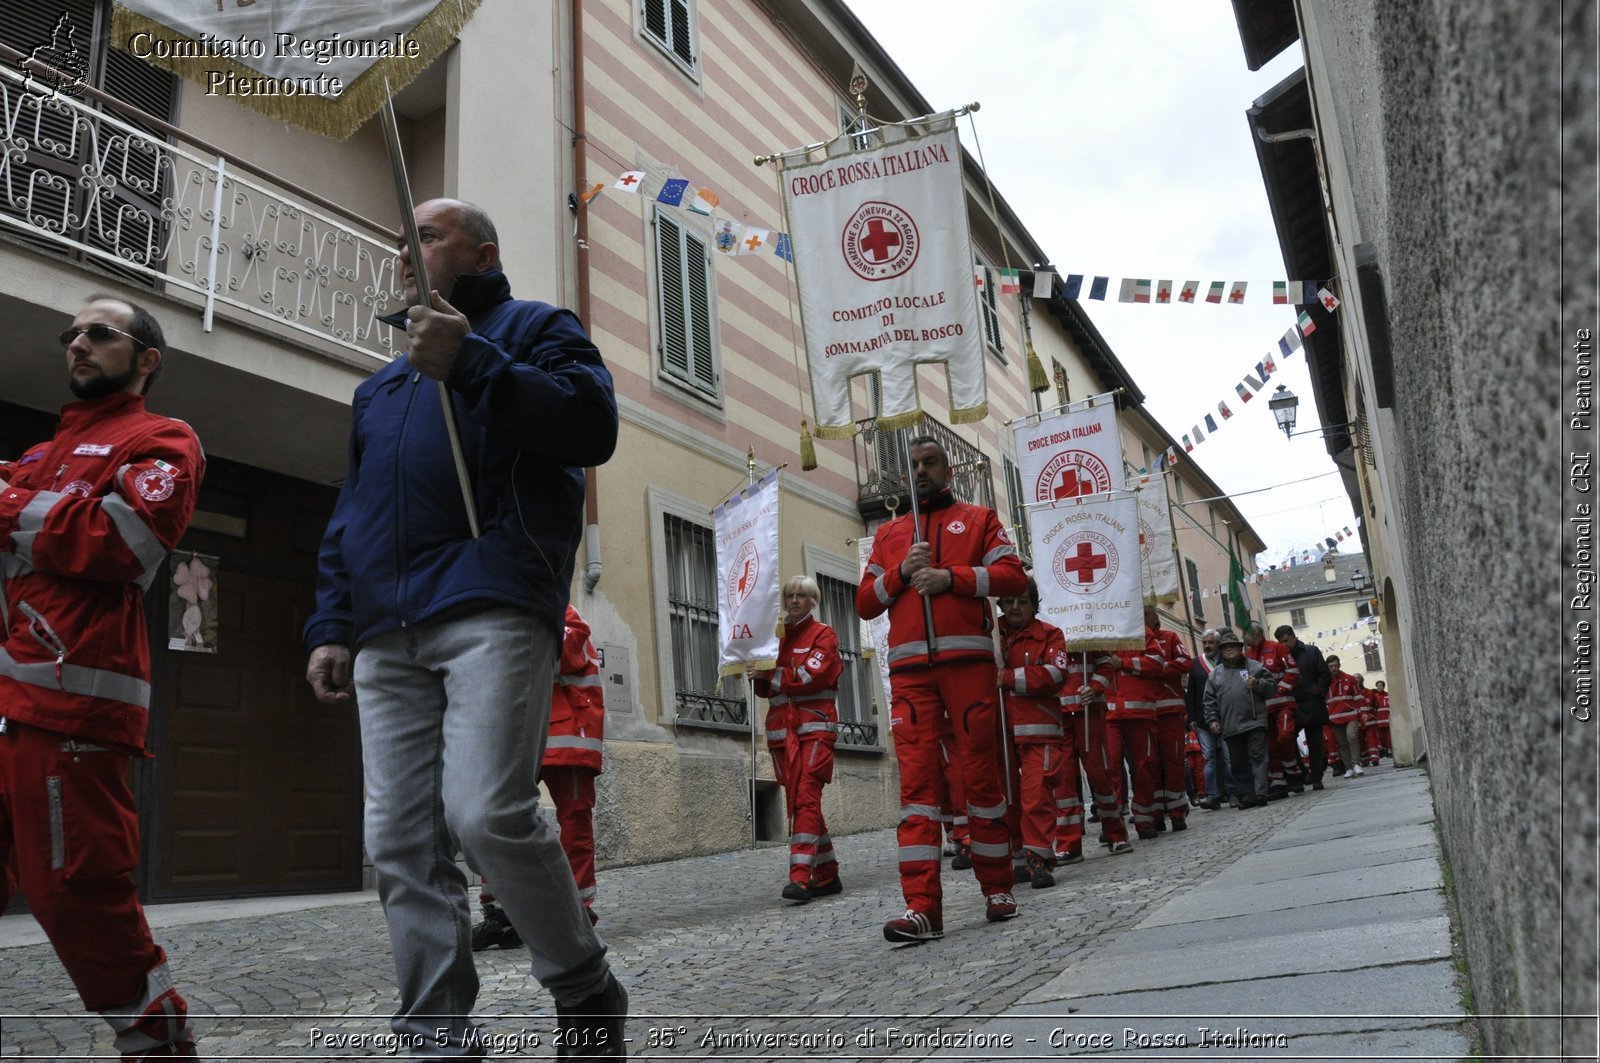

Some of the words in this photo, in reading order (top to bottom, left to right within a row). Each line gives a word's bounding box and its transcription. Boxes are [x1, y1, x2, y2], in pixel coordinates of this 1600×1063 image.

[791, 169, 837, 197] CROCE
[837, 160, 880, 187] ROSSA
[881, 143, 950, 176] ITALIANA
[853, 220, 861, 230] DI
[860, 206, 892, 222] GINEVRA
[893, 212, 904, 224] 22
[847, 231, 875, 276] CONVENZIONE
[901, 222, 915, 256] AGOSTO
[891, 255, 908, 272] 1864
[832, 297, 892, 322] COMITATO
[894, 291, 946, 308] LOCALE
[882, 313, 895, 327] DI
[824, 331, 893, 359] SOMMARIVA
[894, 329, 919, 342] DEL
[920, 323, 964, 341] BOSCO
[1028, 436, 1050, 452] CROCE
[1050, 430, 1072, 445] ROSSA
[1072, 422, 1102, 439] ITALIANA
[1039, 453, 1071, 501] ONVENZIONE
[1085, 457, 1108, 492] GINEVRA
[1042, 521, 1065, 545] CROCE
[1065, 512, 1092, 525] ROSSA
[1095, 513, 1125, 535] ITALIANA
[1053, 547, 1071, 589] CONVENZIONE
[1064, 539, 1072, 548] DI
[1071, 533, 1100, 543] GINEVRA
[1099, 537, 1107, 546] 22
[1106, 544, 1117, 571] AGOSTO
[1047, 603, 1092, 615] COMITATO
[1095, 600, 1131, 611] LOCALE
[1065, 624, 1115, 635] DRONERO
